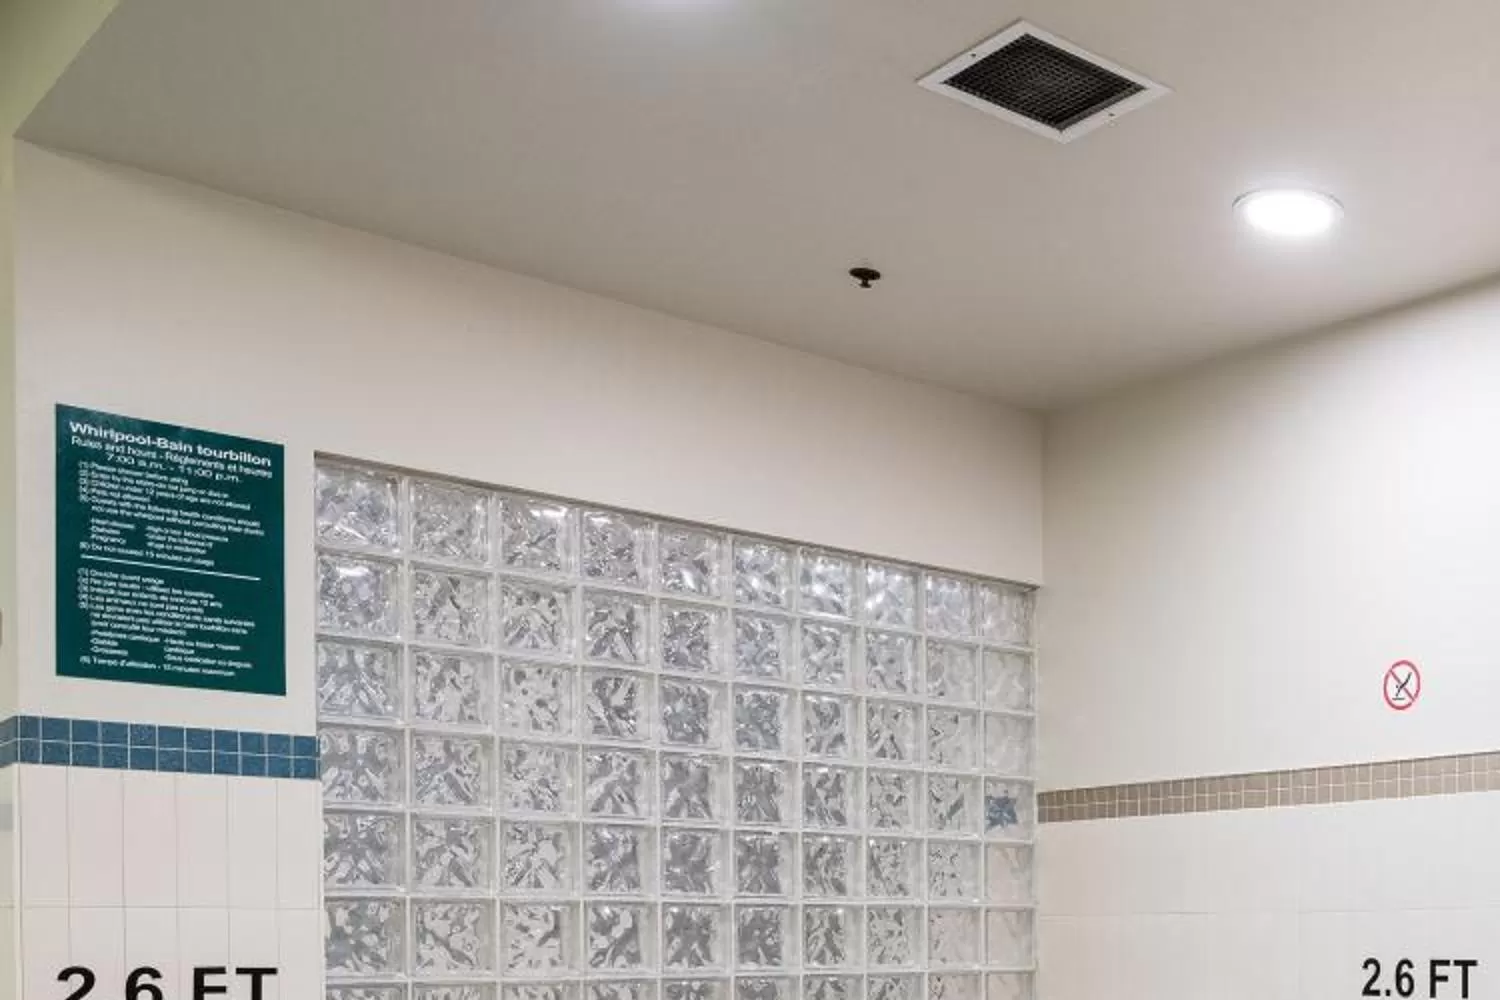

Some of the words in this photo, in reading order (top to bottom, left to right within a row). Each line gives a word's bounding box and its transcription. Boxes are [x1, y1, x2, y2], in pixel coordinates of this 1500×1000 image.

[69, 421, 193, 453] Whirlpool-Bain
[196, 444, 271, 467] tourbillon
[71, 435, 102, 450] Rules
[1361, 957, 1415, 998] 2.6
[1429, 958, 1478, 999] FT
